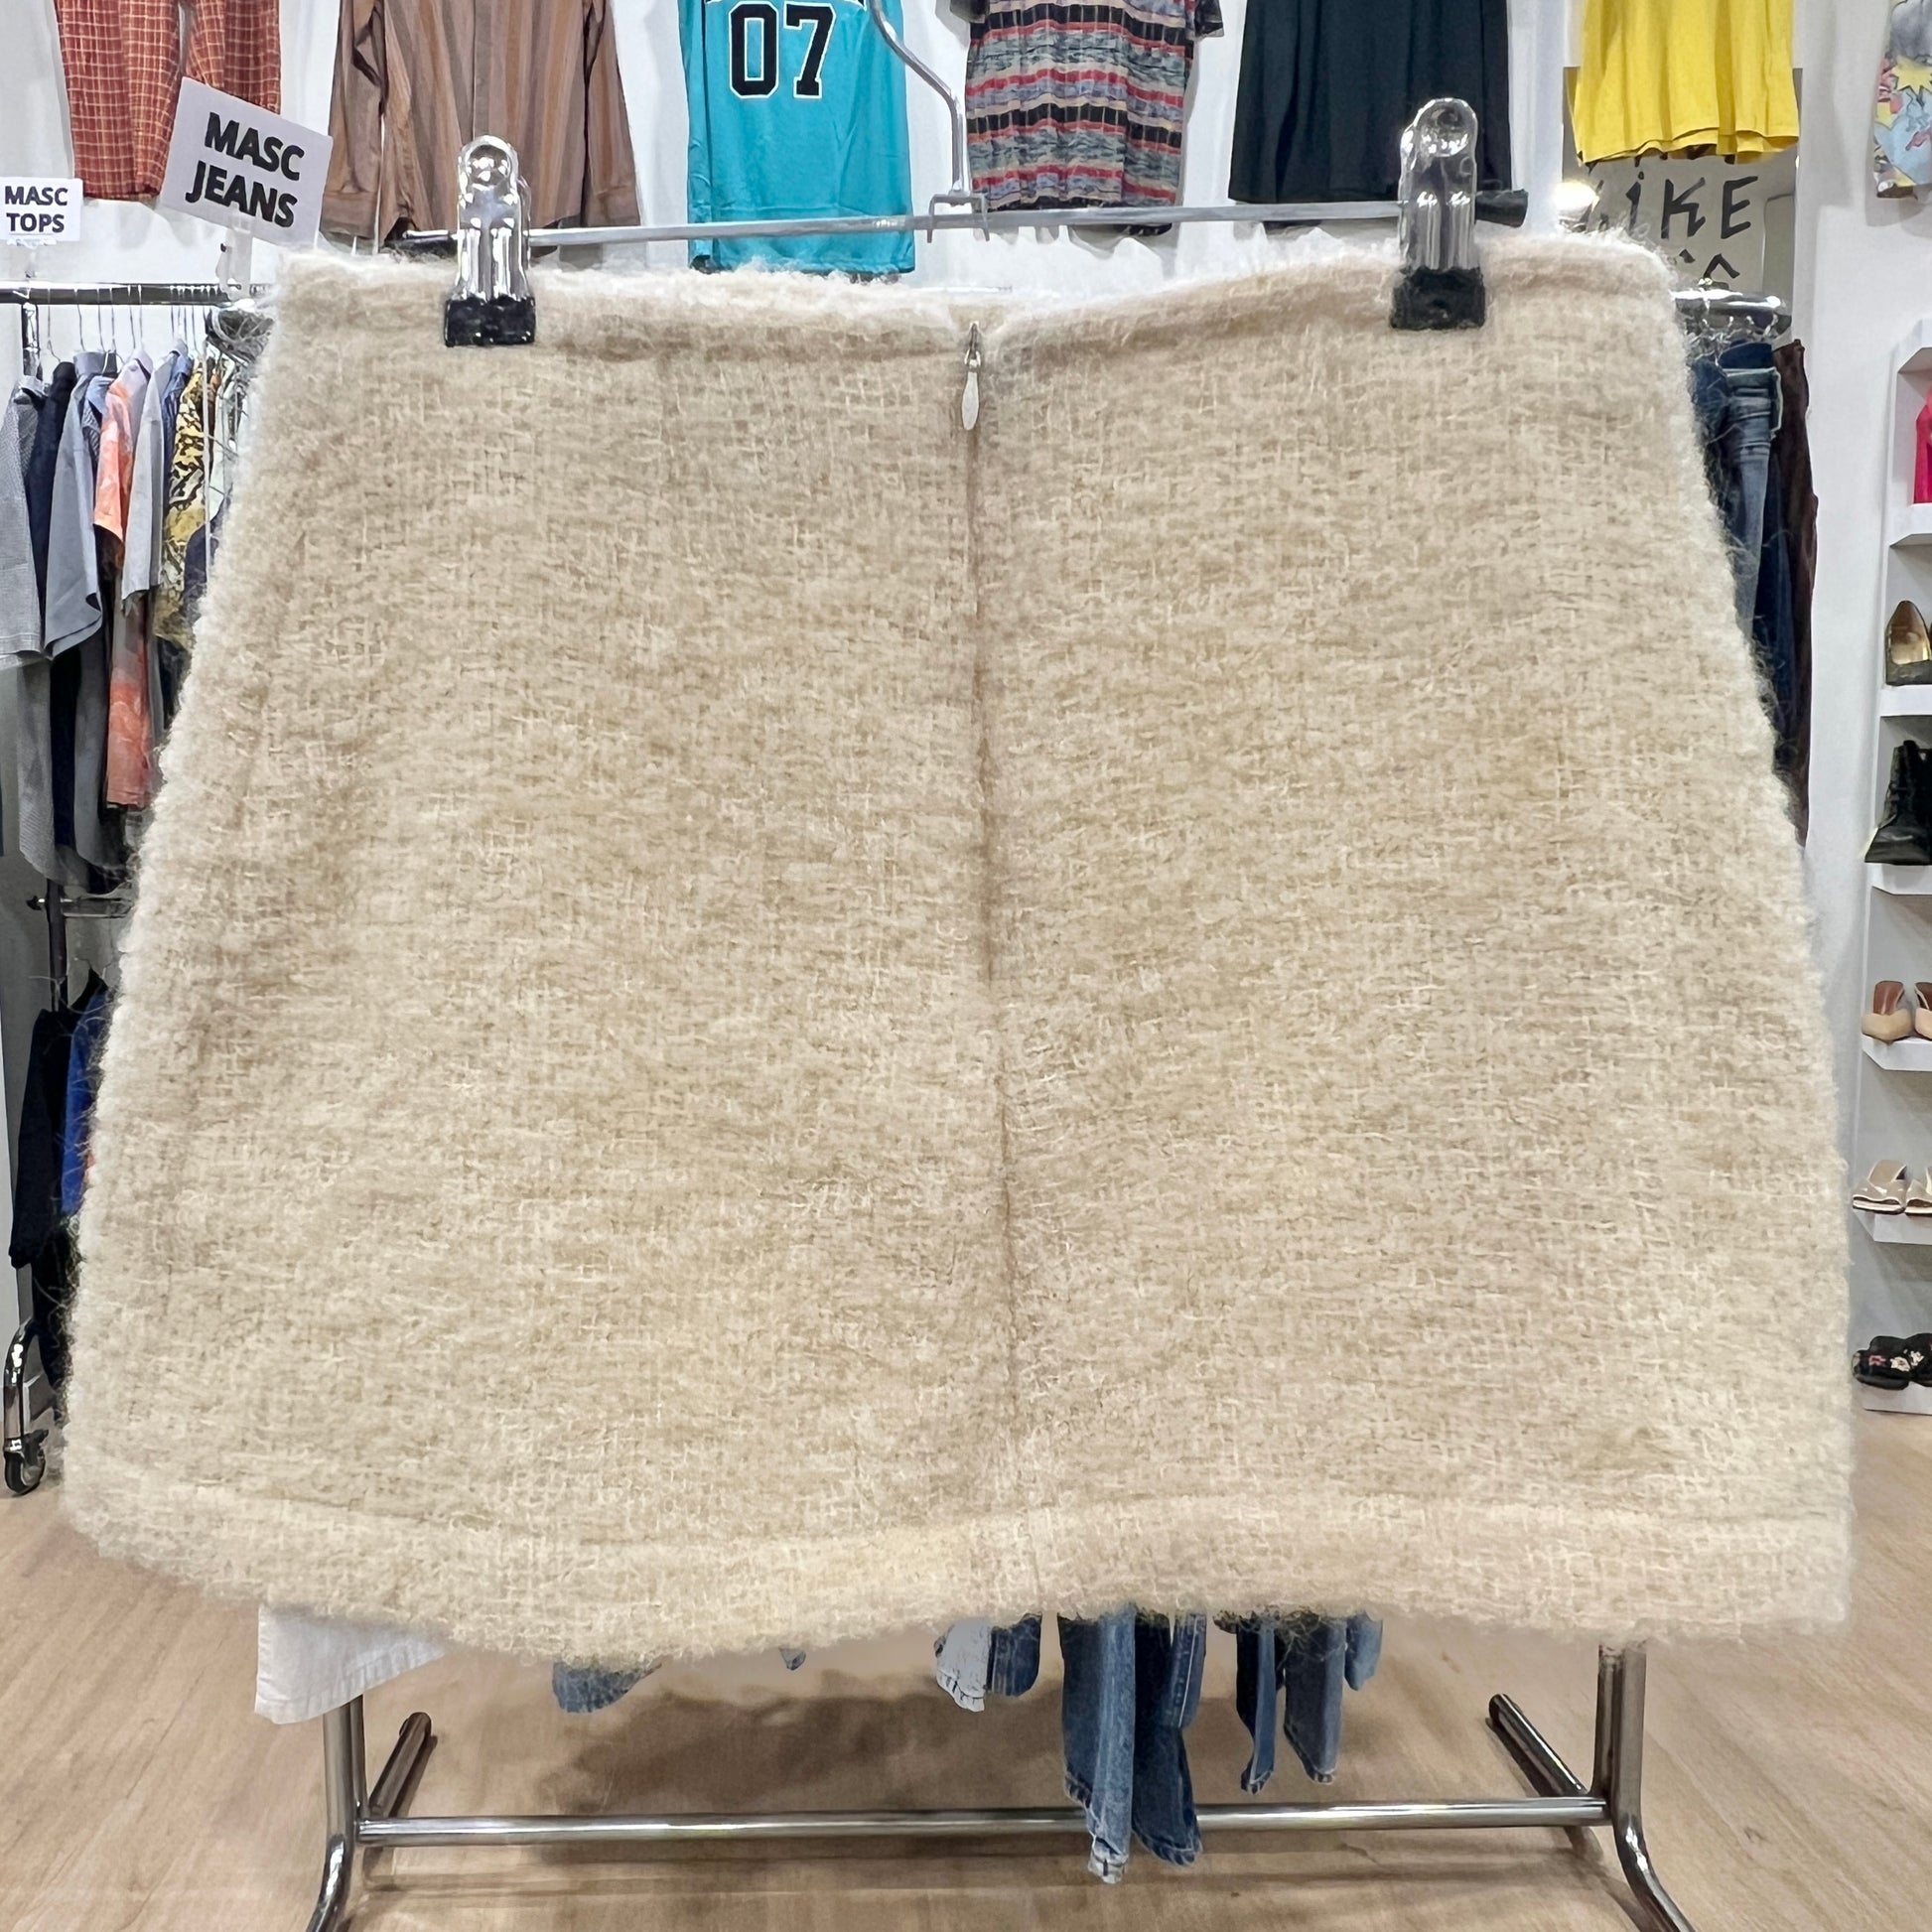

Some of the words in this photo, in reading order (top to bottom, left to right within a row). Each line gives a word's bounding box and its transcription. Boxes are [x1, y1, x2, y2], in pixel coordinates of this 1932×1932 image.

[729, 1, 837, 98] 07
[205, 111, 305, 181] MASC
[5, 186, 69, 206] MASC
[6, 212, 65, 233] TOPS
[185, 160, 298, 228] JEANS
